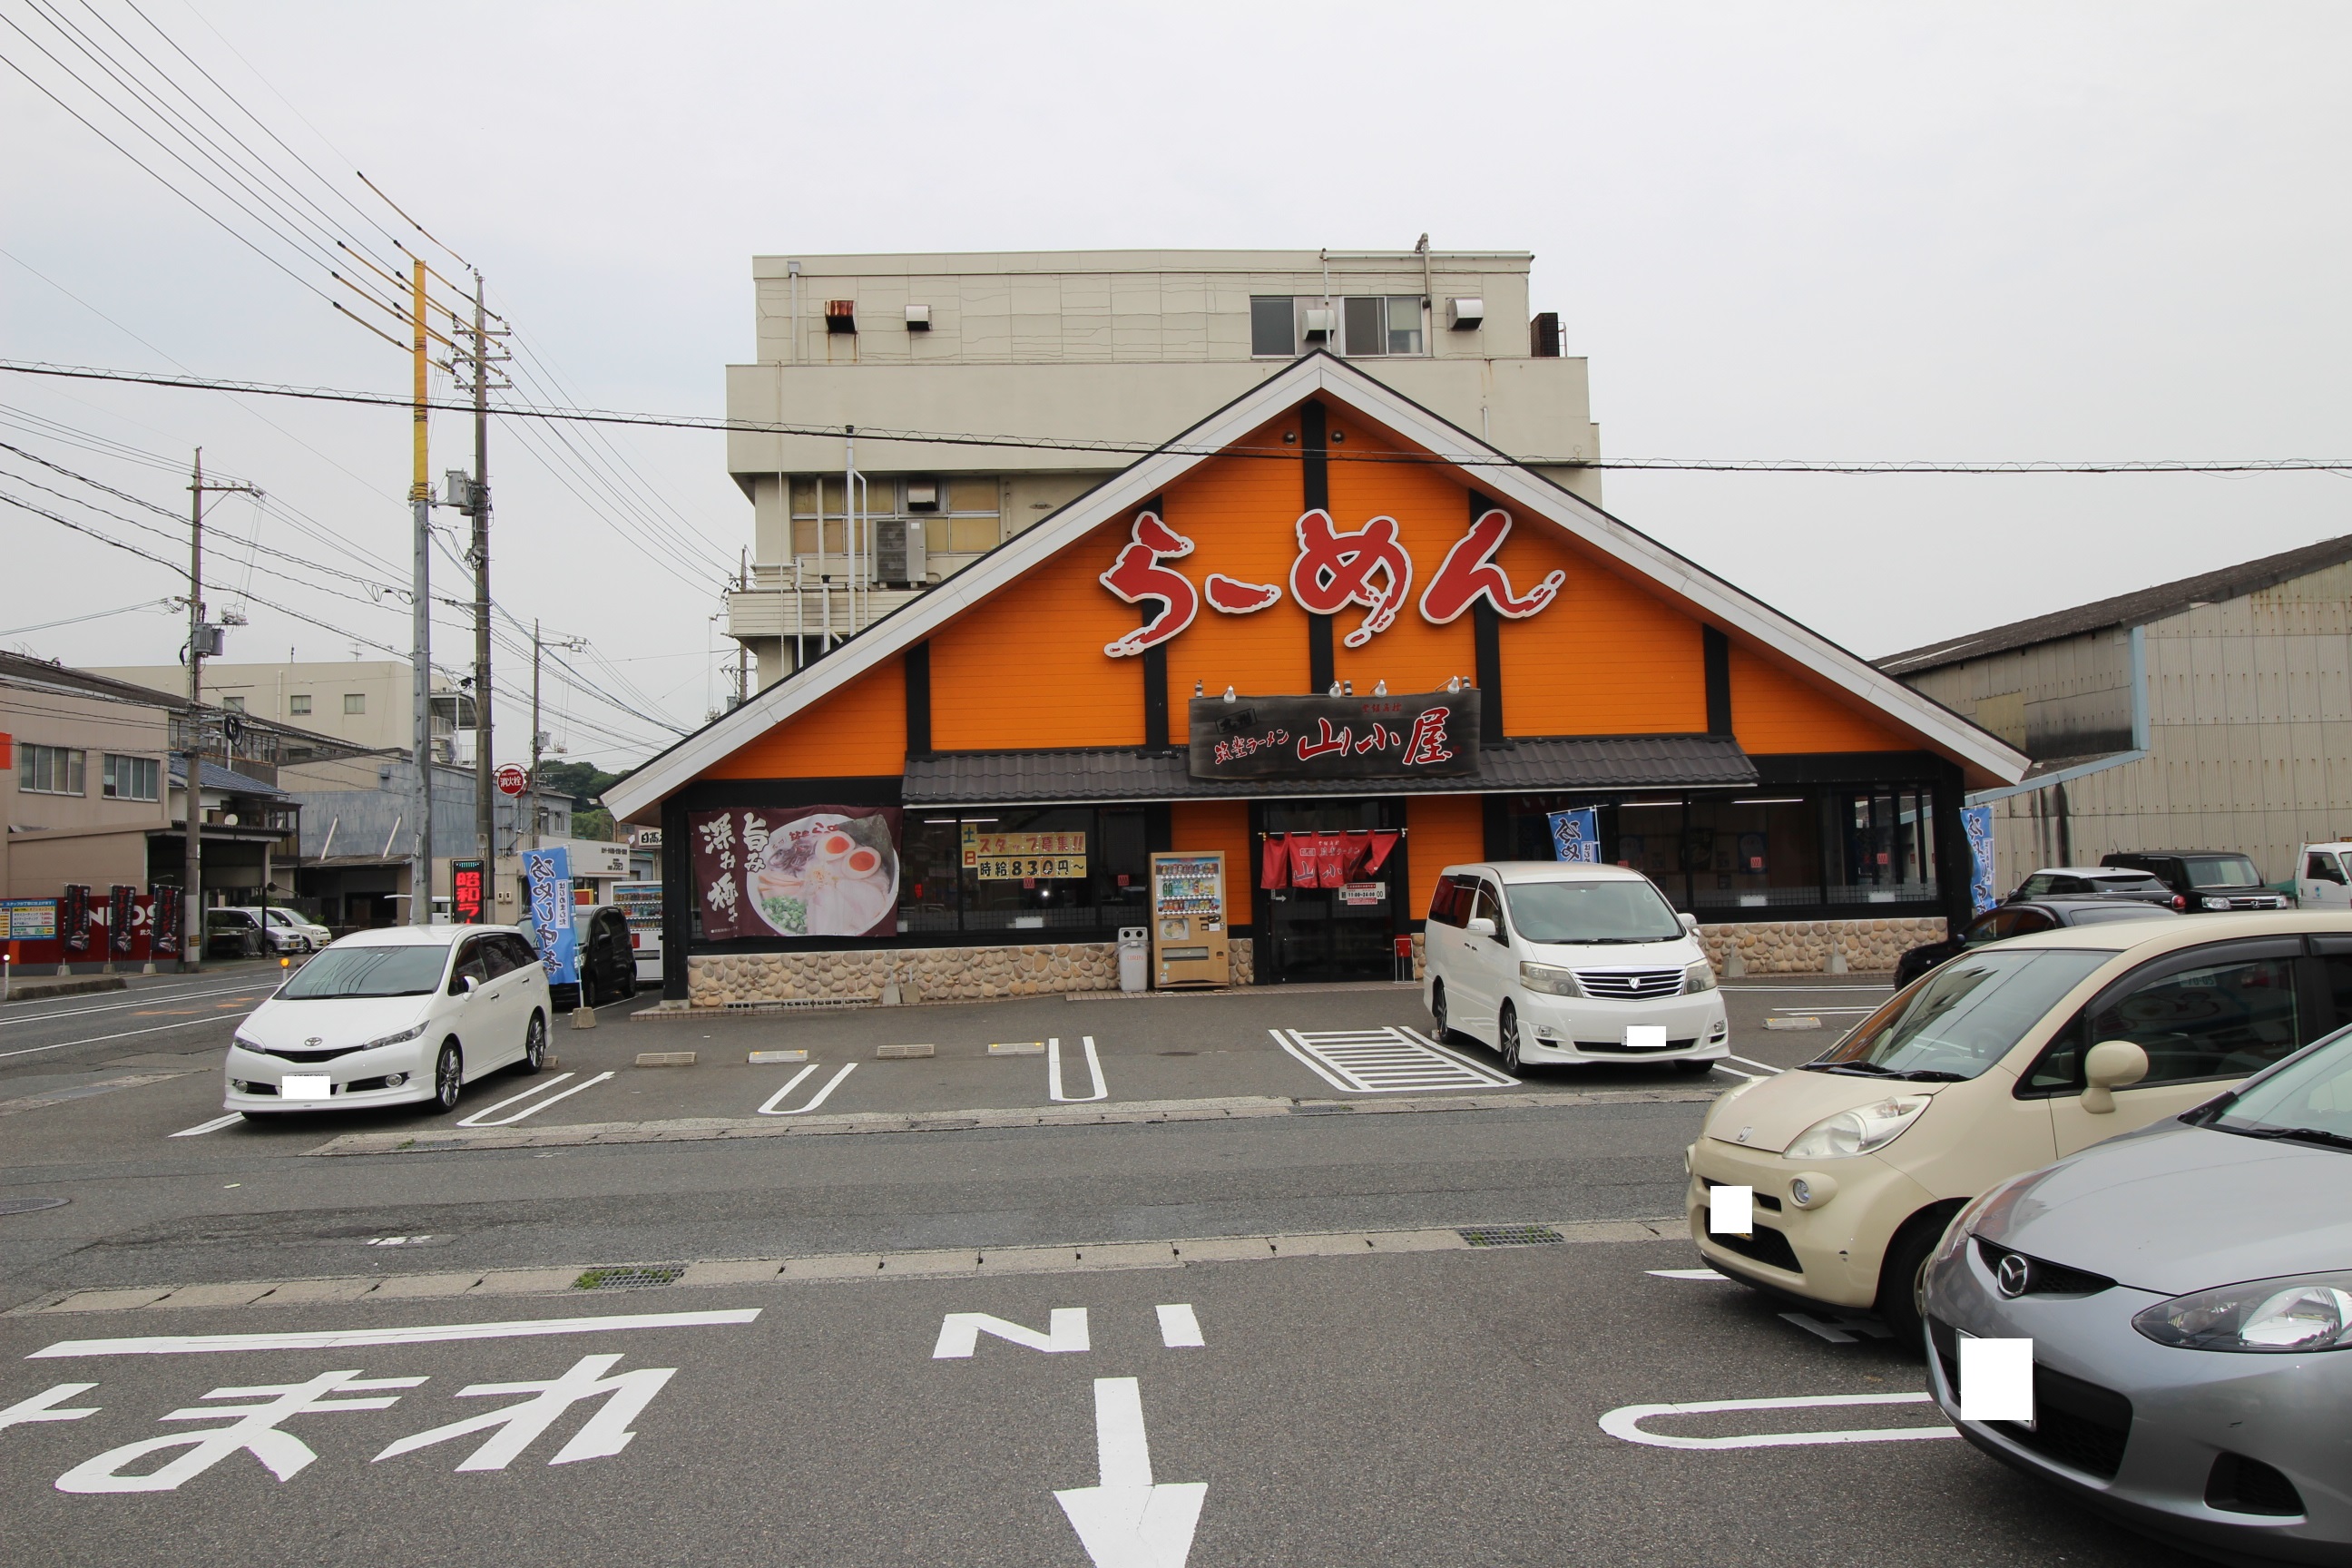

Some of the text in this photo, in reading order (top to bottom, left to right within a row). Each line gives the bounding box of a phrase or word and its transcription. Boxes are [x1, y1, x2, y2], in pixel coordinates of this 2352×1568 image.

[1099, 508, 1565, 657] らーめん
[1214, 706, 1453, 765] 筑豊ラーメン 山小屋
[500, 776, 522, 788] 消火栓
[742, 812, 770, 873] 旨み
[964, 827, 976, 866] 土日
[456, 872, 481, 925] 昭和ラ
